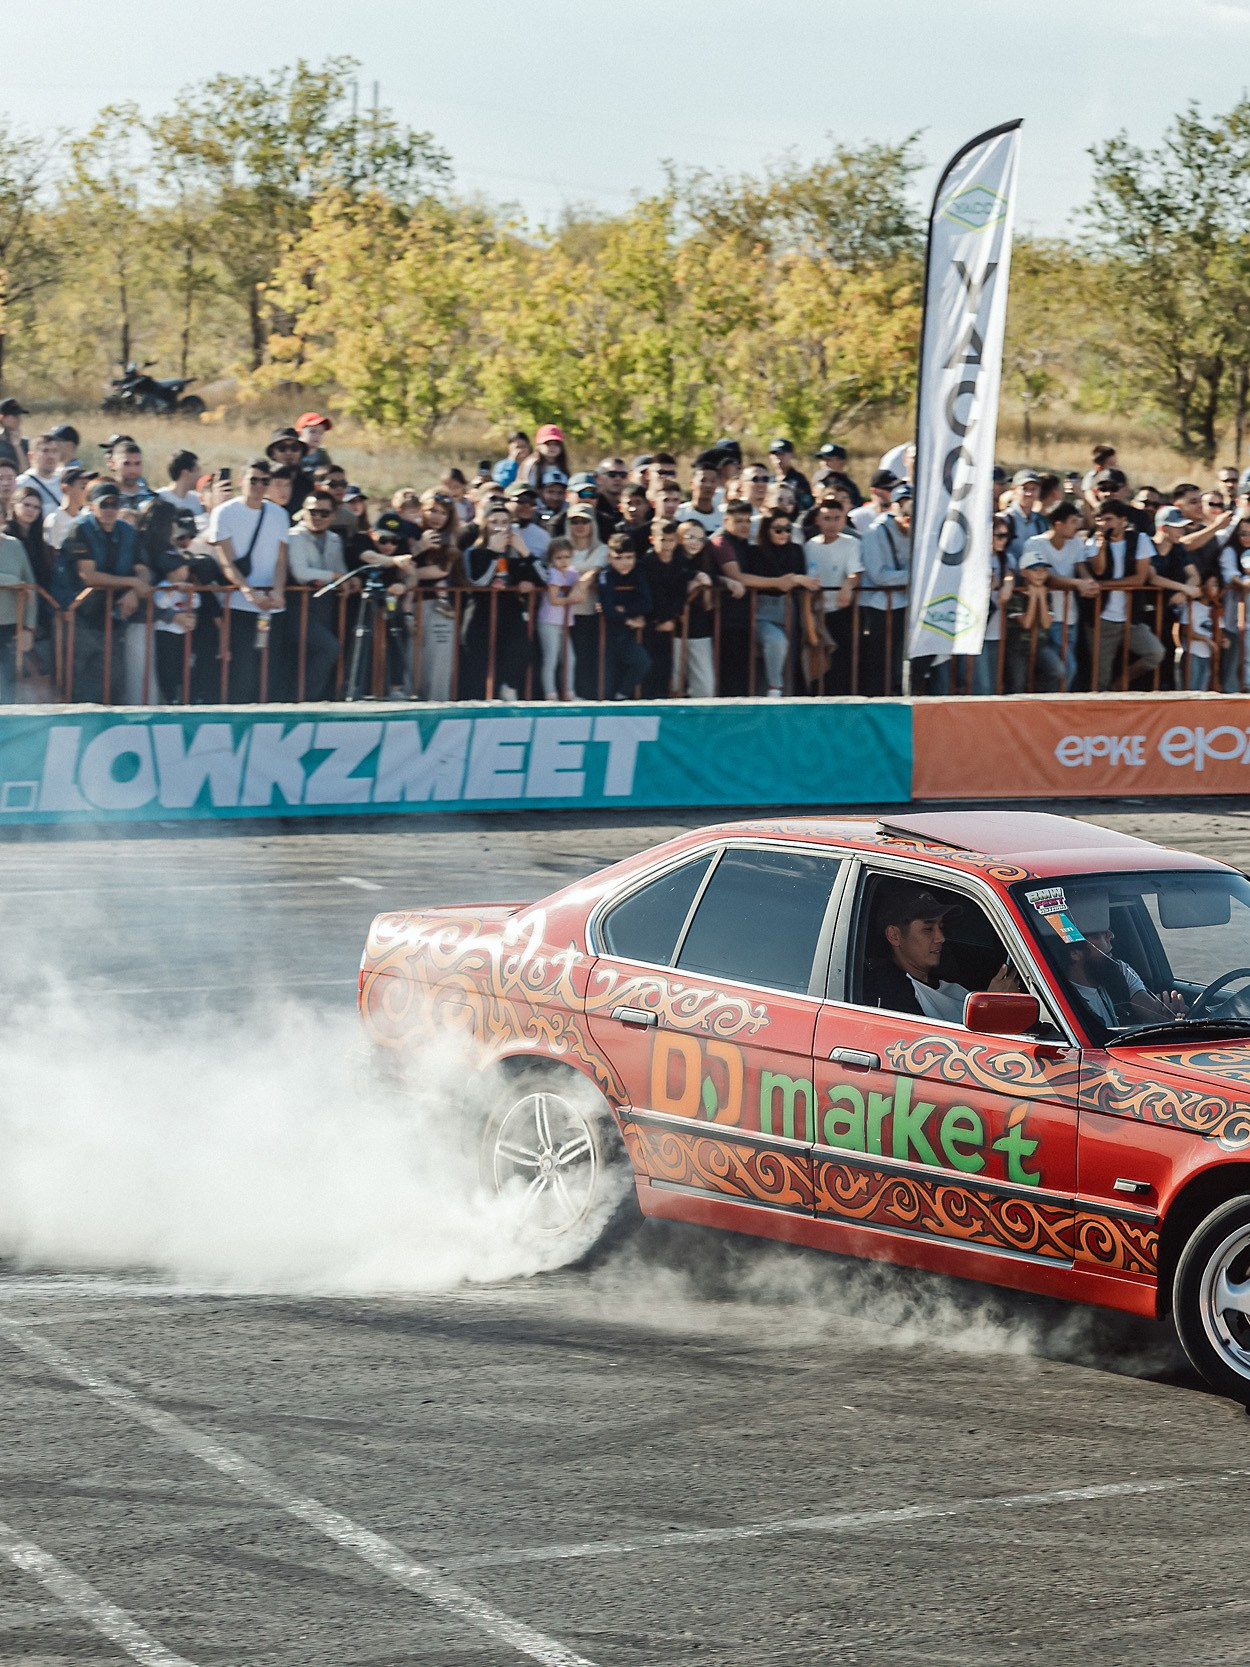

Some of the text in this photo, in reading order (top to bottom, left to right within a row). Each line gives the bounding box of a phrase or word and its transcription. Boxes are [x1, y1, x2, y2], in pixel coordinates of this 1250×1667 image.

[938, 260, 998, 566] YACCO
[40, 716, 660, 811] LOWKZMEET
[761, 1070, 1040, 1187] market
